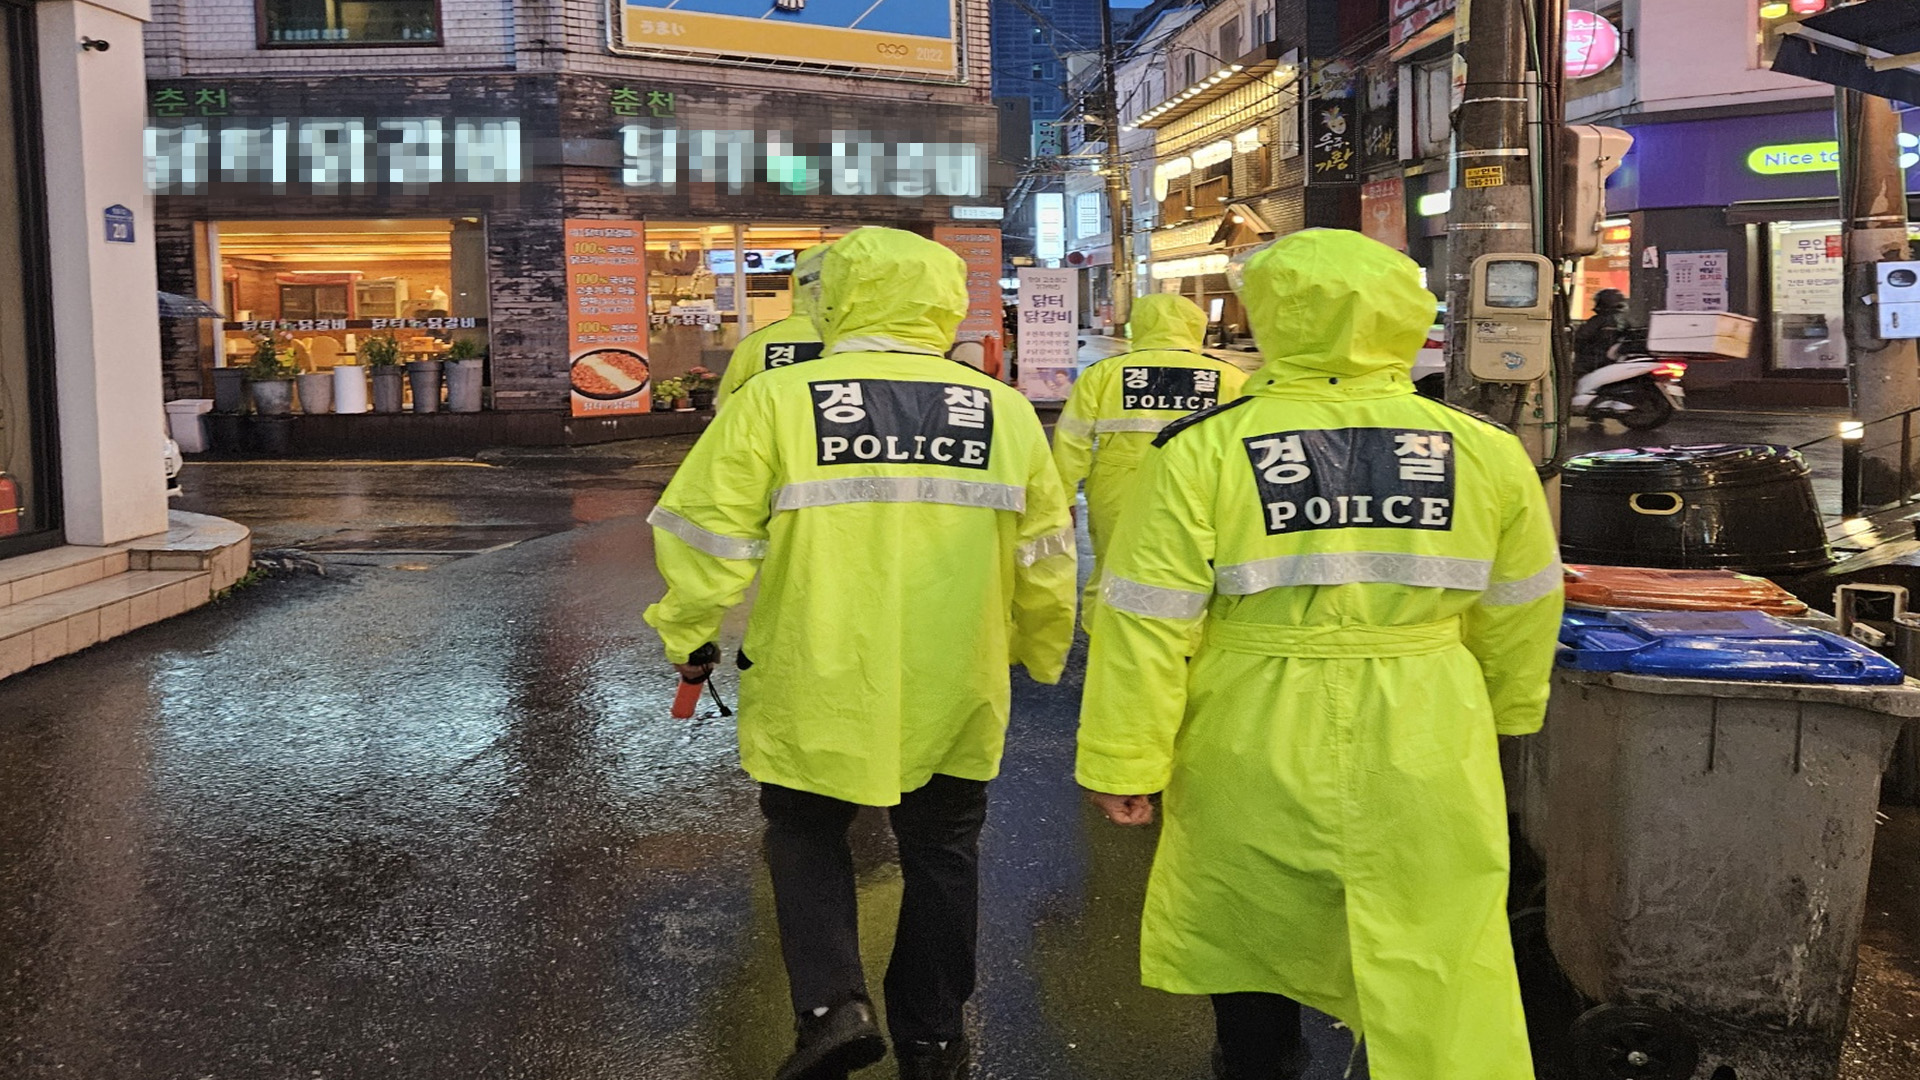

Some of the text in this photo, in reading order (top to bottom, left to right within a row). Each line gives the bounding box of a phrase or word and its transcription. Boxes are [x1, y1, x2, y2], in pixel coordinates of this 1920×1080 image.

[640, 19, 686, 36] うまい
[915, 46, 944, 63] 2022
[153, 88, 228, 117] 춘천
[611, 88, 676, 118] 춘천
[1764, 152, 1813, 167] Nice
[112, 223, 127, 238] 20
[1031, 294, 1064, 308] 닭터
[1023, 310, 1072, 324] 닭갈비
[821, 434, 988, 466] POLICE
